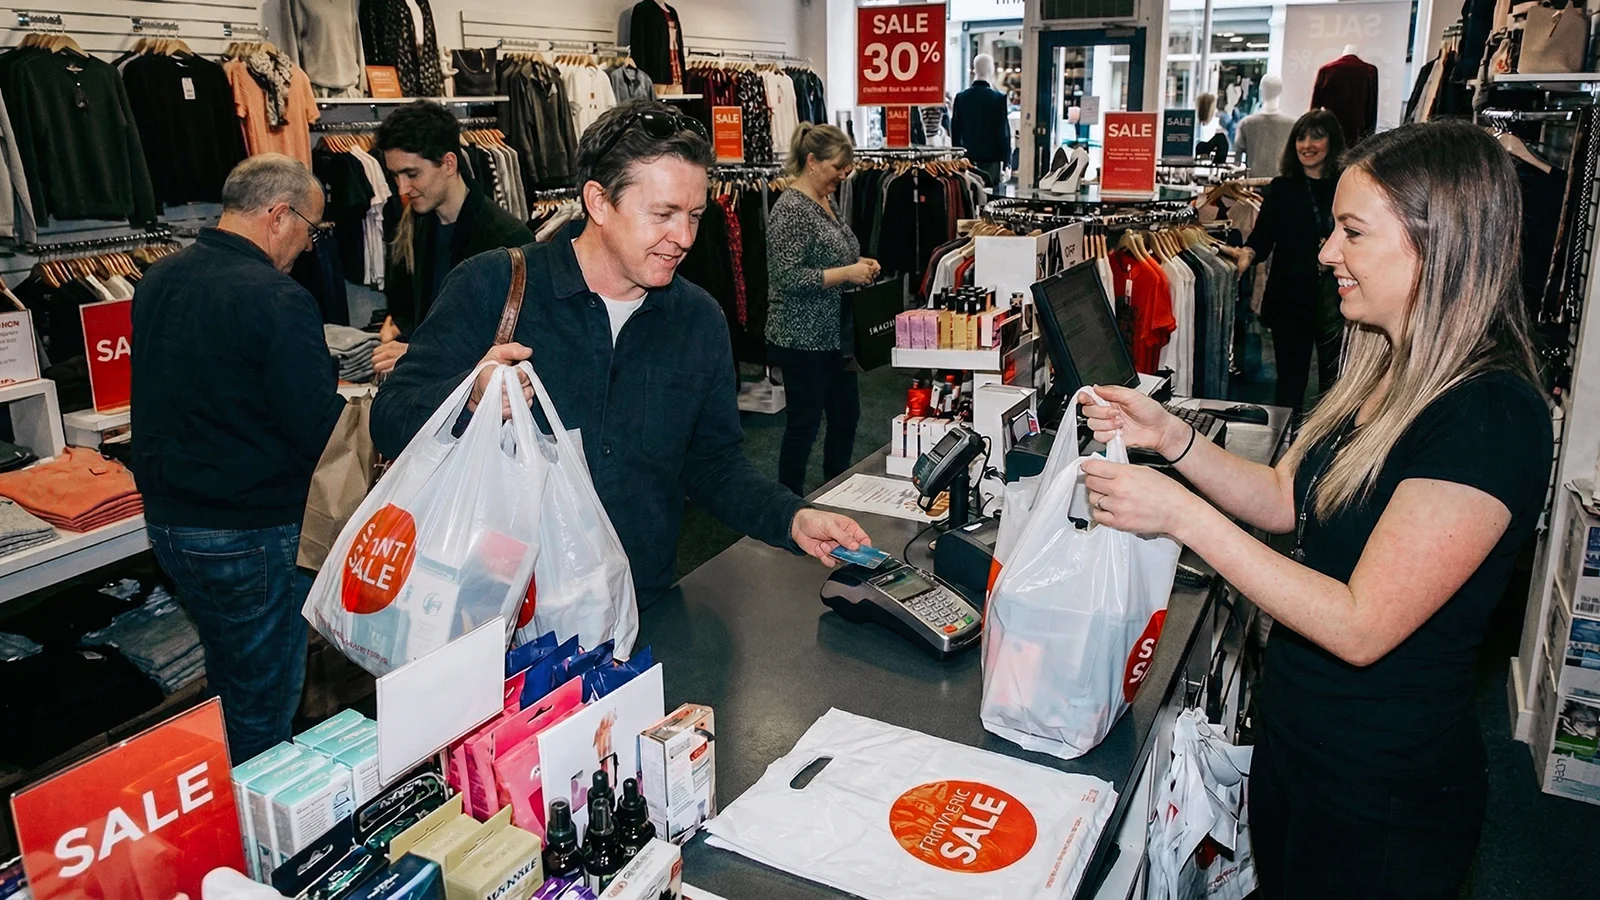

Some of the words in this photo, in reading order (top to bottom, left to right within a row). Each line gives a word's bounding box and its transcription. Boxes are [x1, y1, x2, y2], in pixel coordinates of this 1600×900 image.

[873, 13, 929, 35] SALE
[863, 41, 940, 82] 30%
[715, 114, 740, 124] SALE
[888, 110, 908, 119] SALE
[1167, 117, 1192, 126] SALE
[1108, 123, 1152, 138] SALE
[348, 544, 396, 591] SALE
[54, 761, 214, 878] SALE
[939, 792, 1008, 865] SALE
